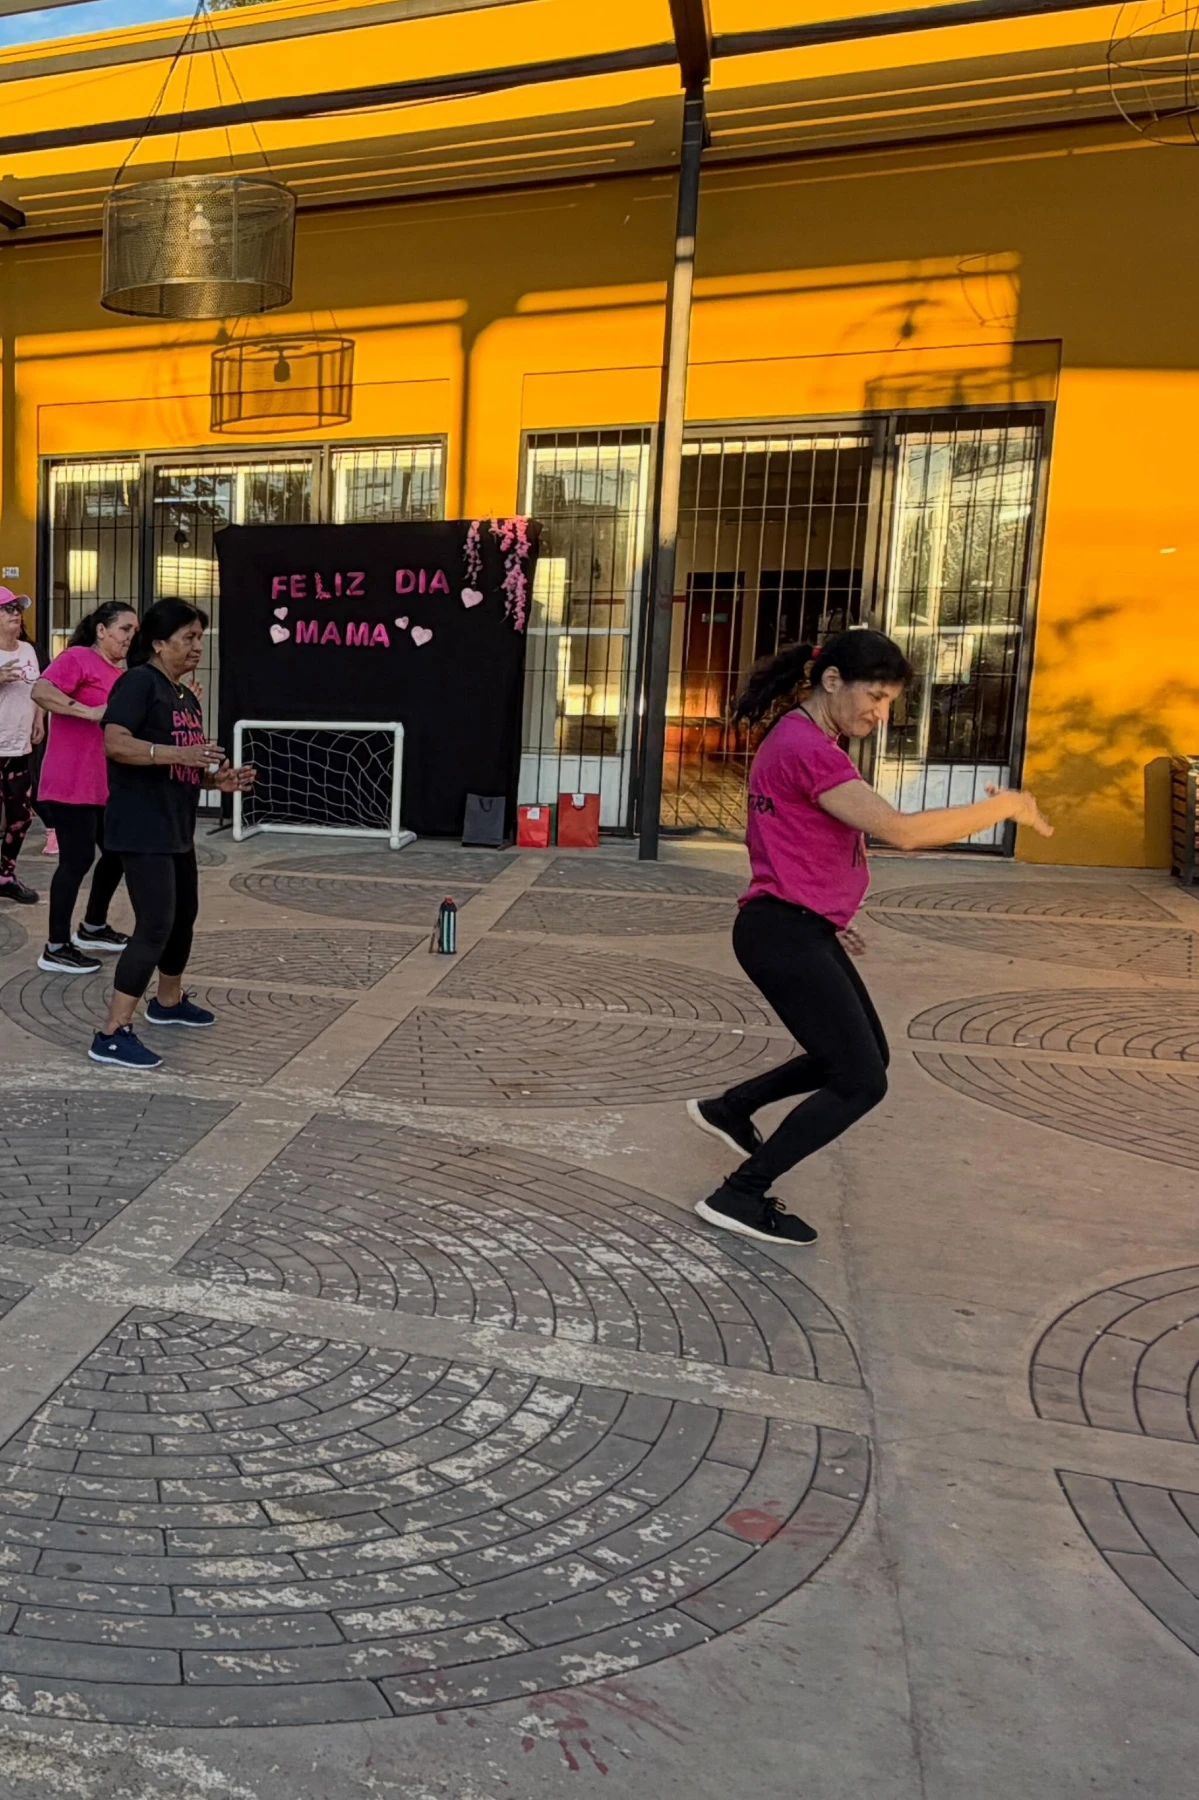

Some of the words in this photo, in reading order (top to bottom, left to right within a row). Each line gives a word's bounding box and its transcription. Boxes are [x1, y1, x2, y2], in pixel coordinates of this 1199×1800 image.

[271, 571, 366, 600] FELIZ
[395, 568, 450, 594] DIA
[295, 620, 391, 648] MAMA
